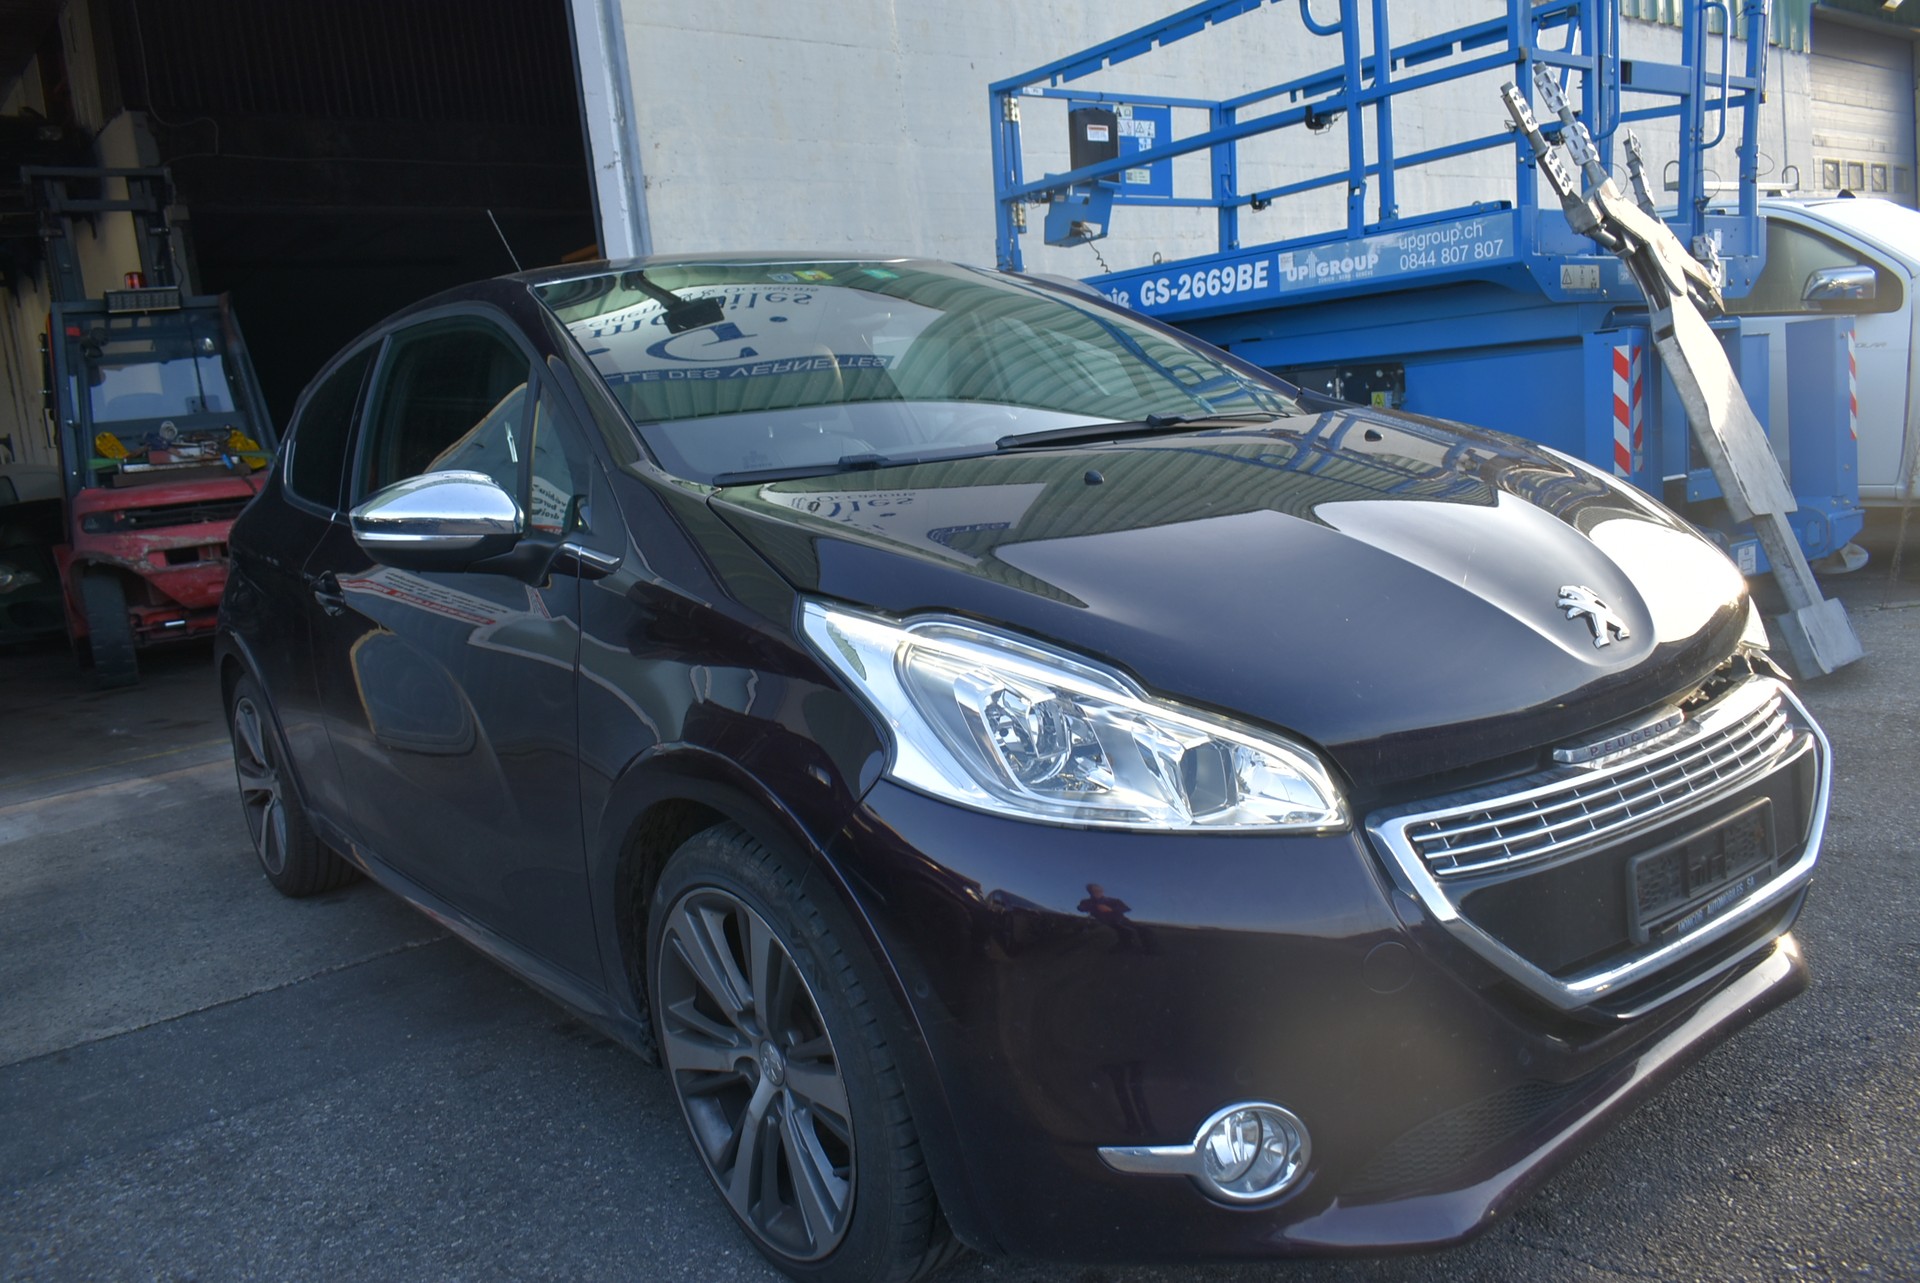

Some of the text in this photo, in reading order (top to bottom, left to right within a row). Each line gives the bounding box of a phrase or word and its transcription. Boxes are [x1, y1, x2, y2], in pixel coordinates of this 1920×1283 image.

[1399, 221, 1483, 252] upgroup.ch
[1400, 239, 1504, 270] 0844 807 807
[1140, 259, 1270, 307] GS-2669BE
[1589, 719, 1673, 757] PEUGEOT
